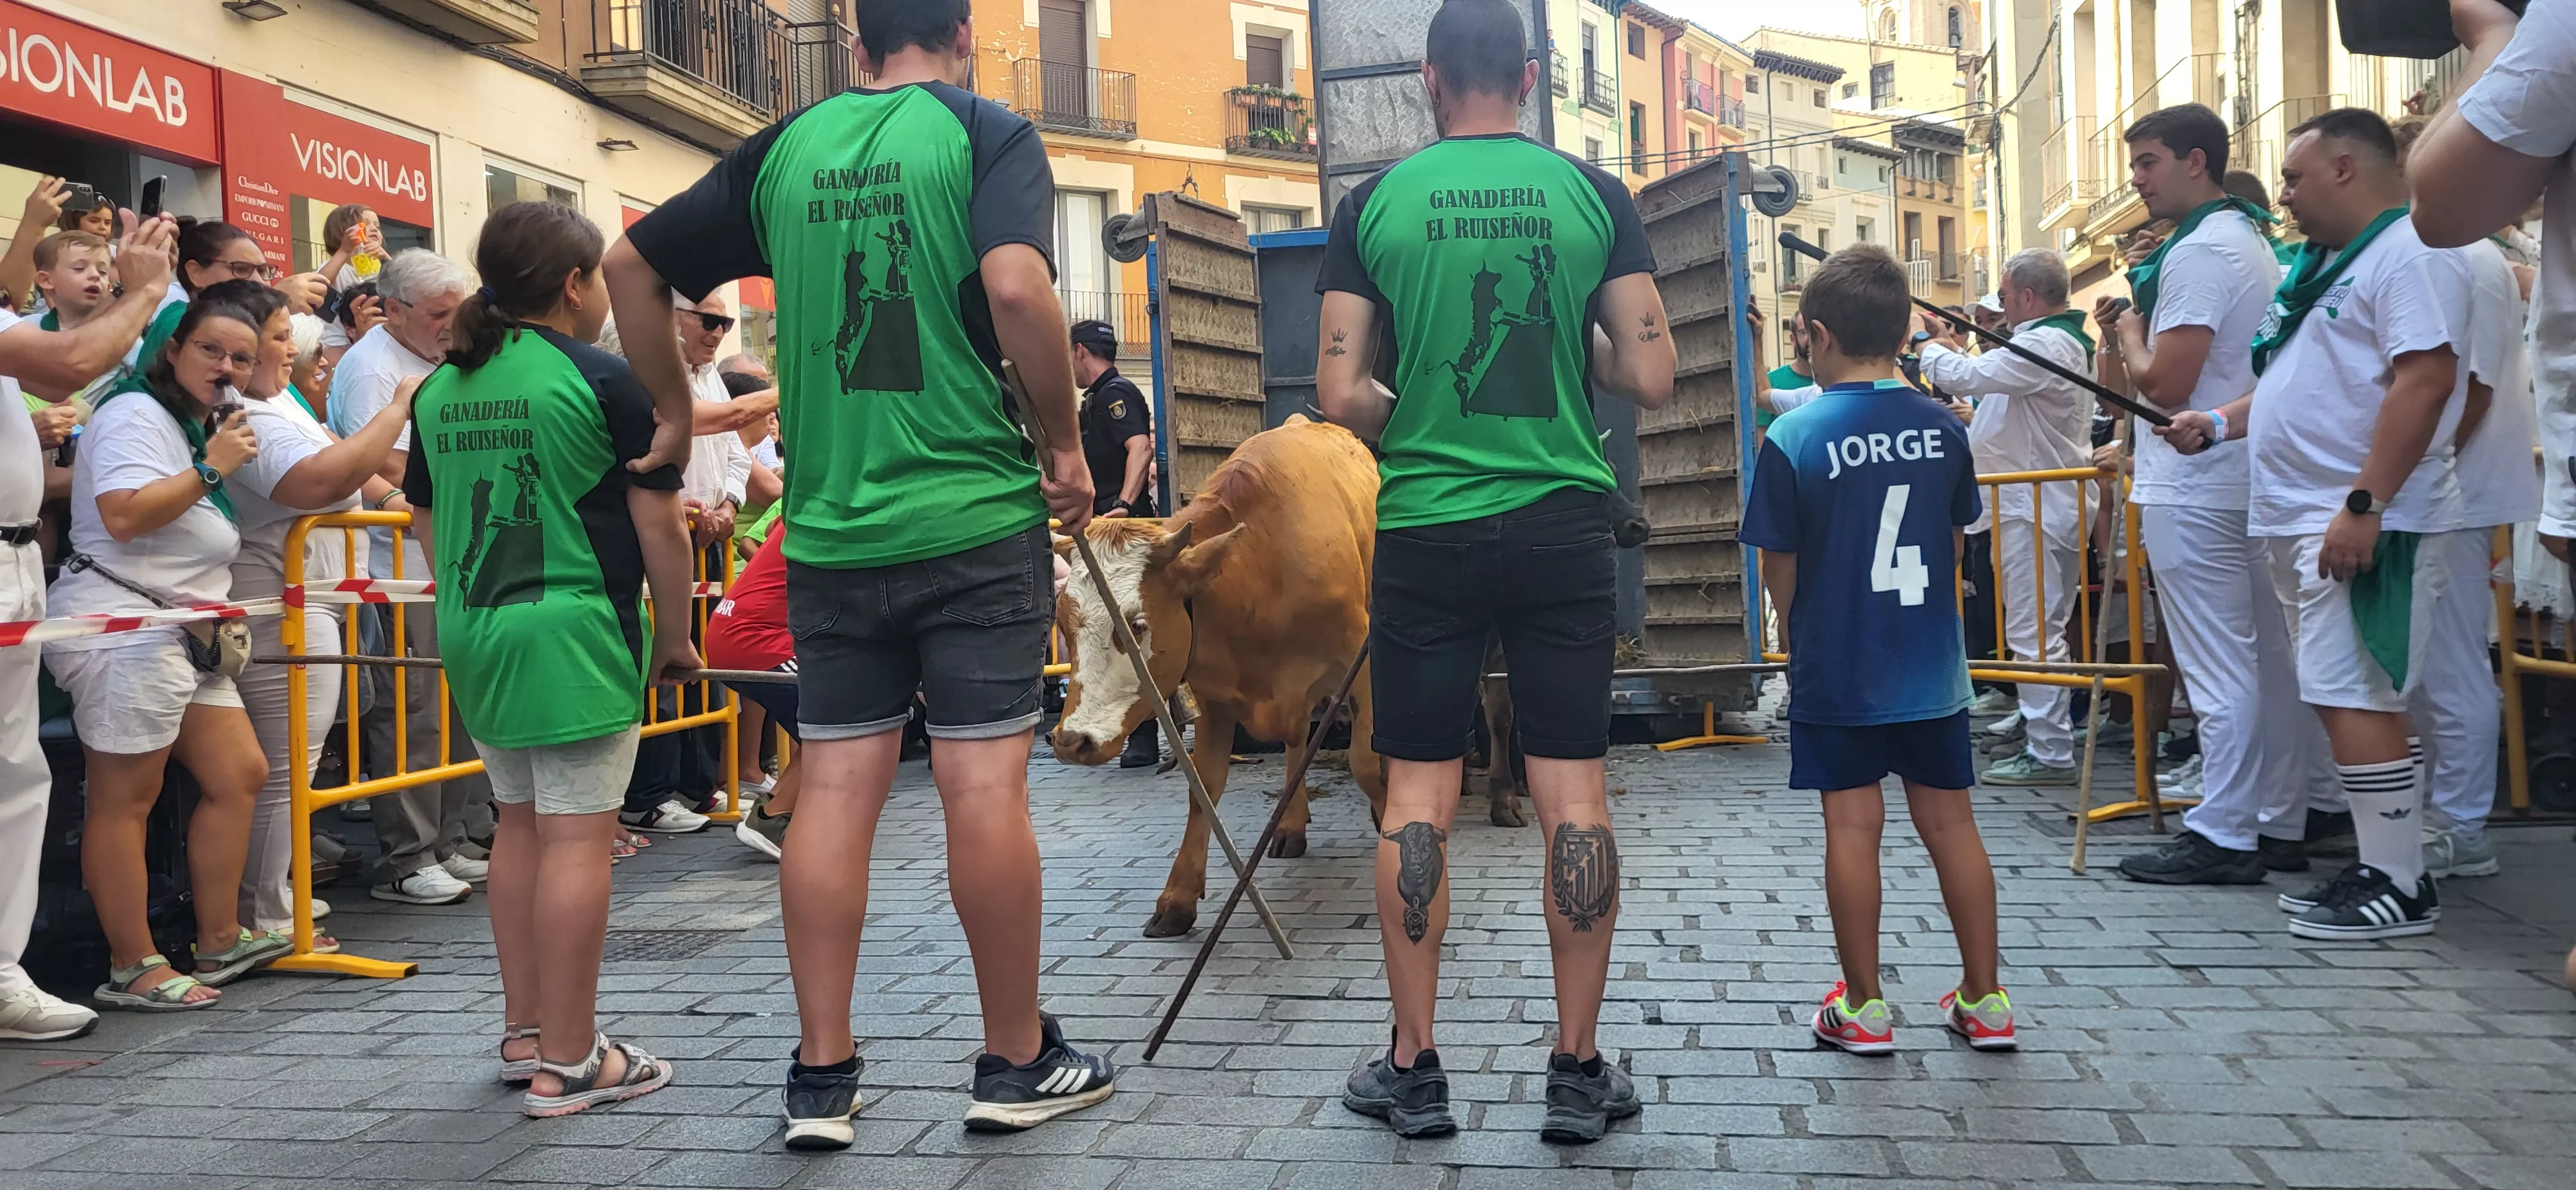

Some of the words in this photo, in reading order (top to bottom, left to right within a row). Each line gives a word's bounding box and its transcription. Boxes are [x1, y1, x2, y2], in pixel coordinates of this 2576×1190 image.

[0, 27, 187, 127] IONLAB
[290, 133, 427, 202] VISIONLAB
[813, 158, 901, 191] GANADERÍA
[808, 200, 828, 223] EL
[834, 191, 905, 222] RUISEÑOR
[1429, 185, 1548, 209] GANADERÍA
[242, 212, 269, 225] GUCCI
[1426, 218, 1448, 242] EL
[1454, 211, 1553, 241] RUISEÑOR
[440, 395, 530, 424] GANADERÍA
[436, 433, 451, 453] EL
[456, 424, 533, 452] RUISEÑOR
[1826, 429, 1945, 480] JORGE
[1871, 484, 1929, 606] 4
